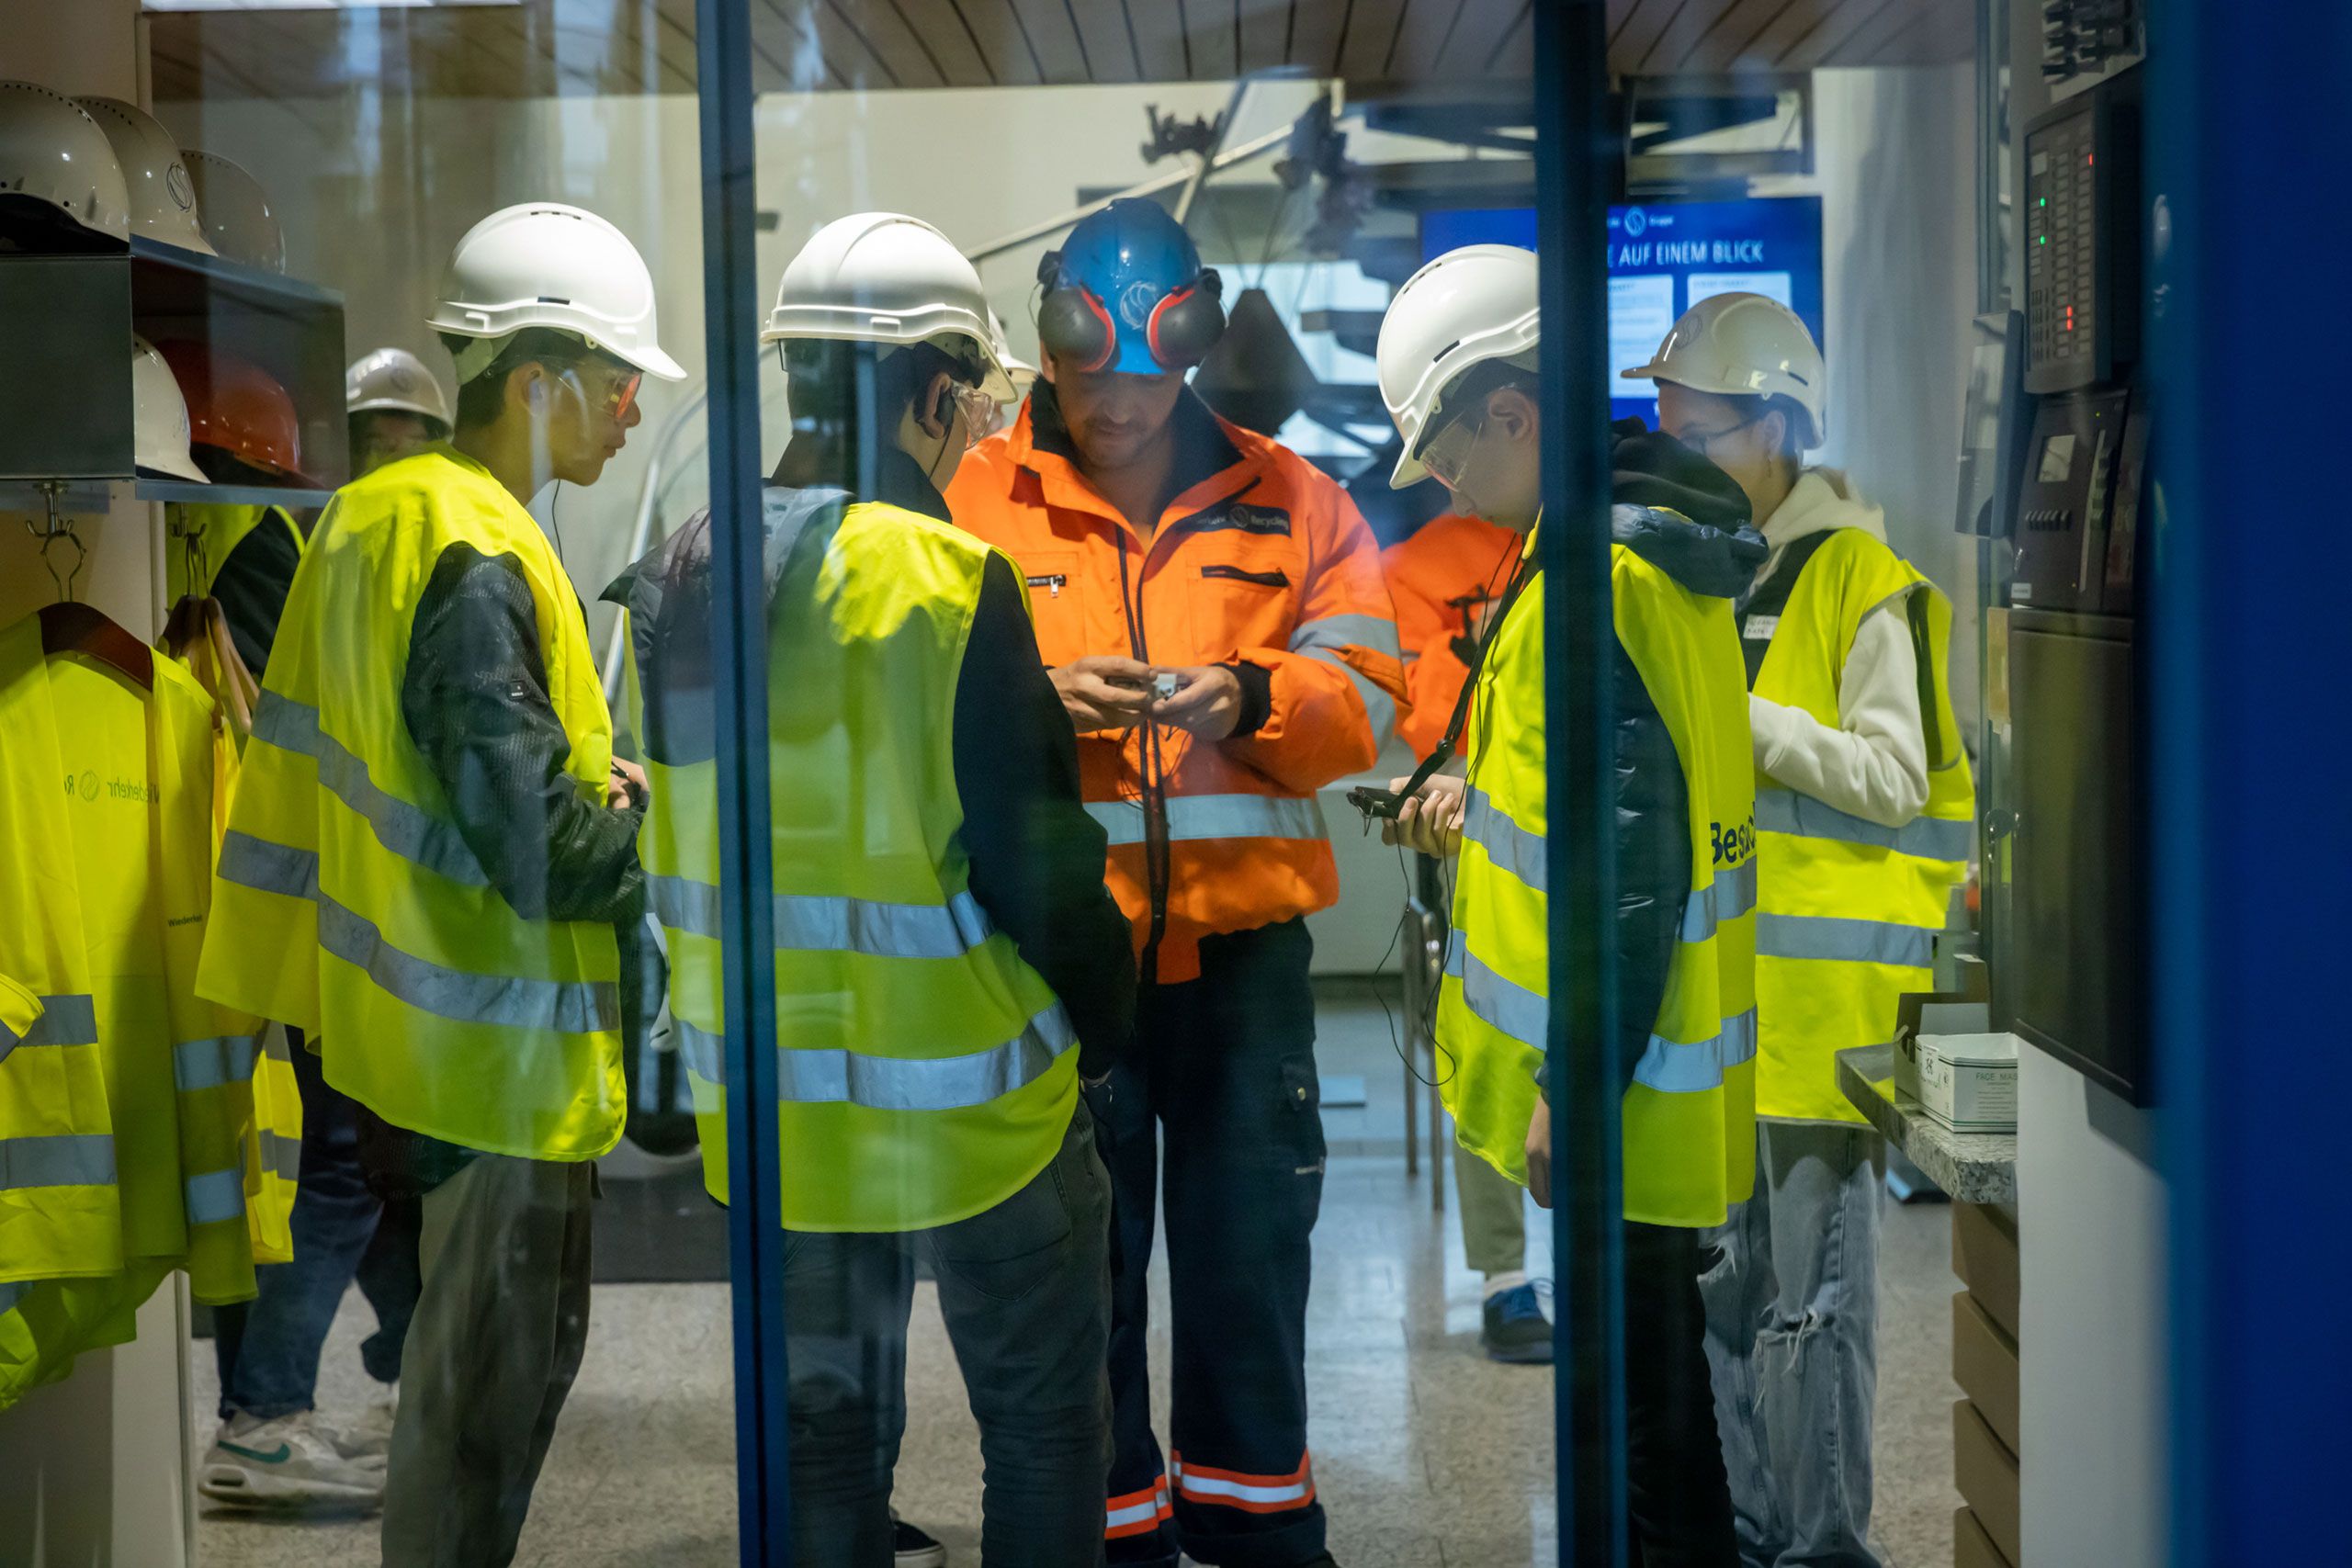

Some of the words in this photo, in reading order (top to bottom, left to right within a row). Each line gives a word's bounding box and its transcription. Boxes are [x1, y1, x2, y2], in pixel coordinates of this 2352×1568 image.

[1619, 243, 1651, 265] AUF
[1657, 240, 1707, 265] EINEM
[1713, 239, 1764, 263] BLICK
[1975, 1072, 1995, 1081] FACE
[1999, 1073, 2018, 1081] MAS
